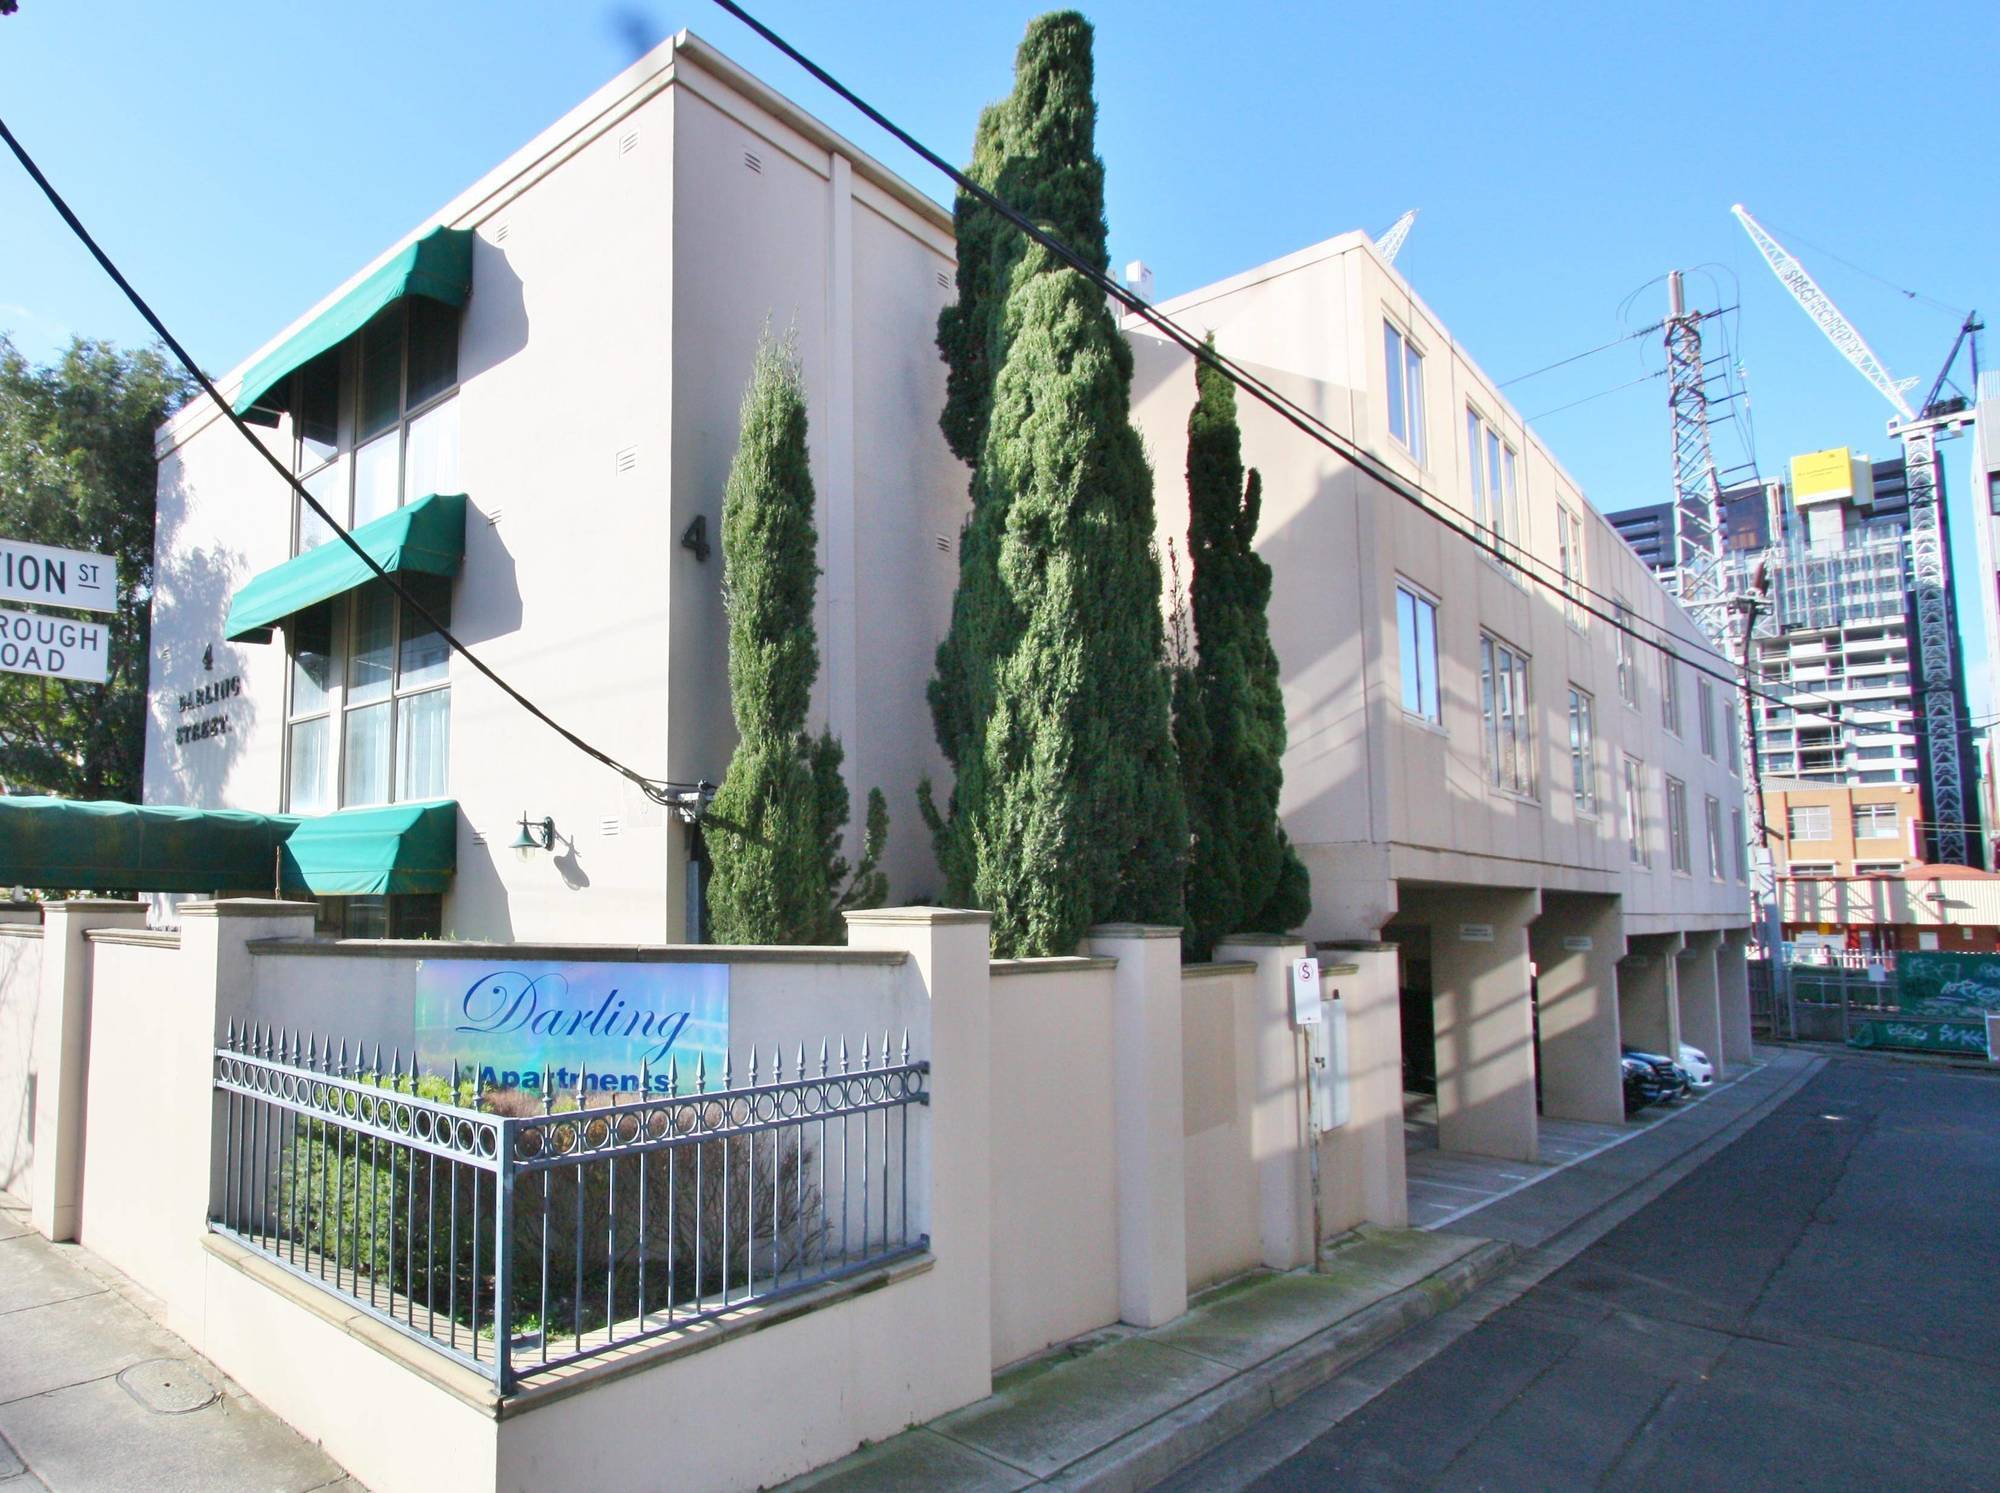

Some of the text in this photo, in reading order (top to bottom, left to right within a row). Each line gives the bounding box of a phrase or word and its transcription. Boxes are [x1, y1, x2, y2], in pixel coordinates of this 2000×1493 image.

[78, 563, 99, 583] ST
[455, 971, 693, 1066] Darling
[479, 1065, 670, 1092] Apatmens
